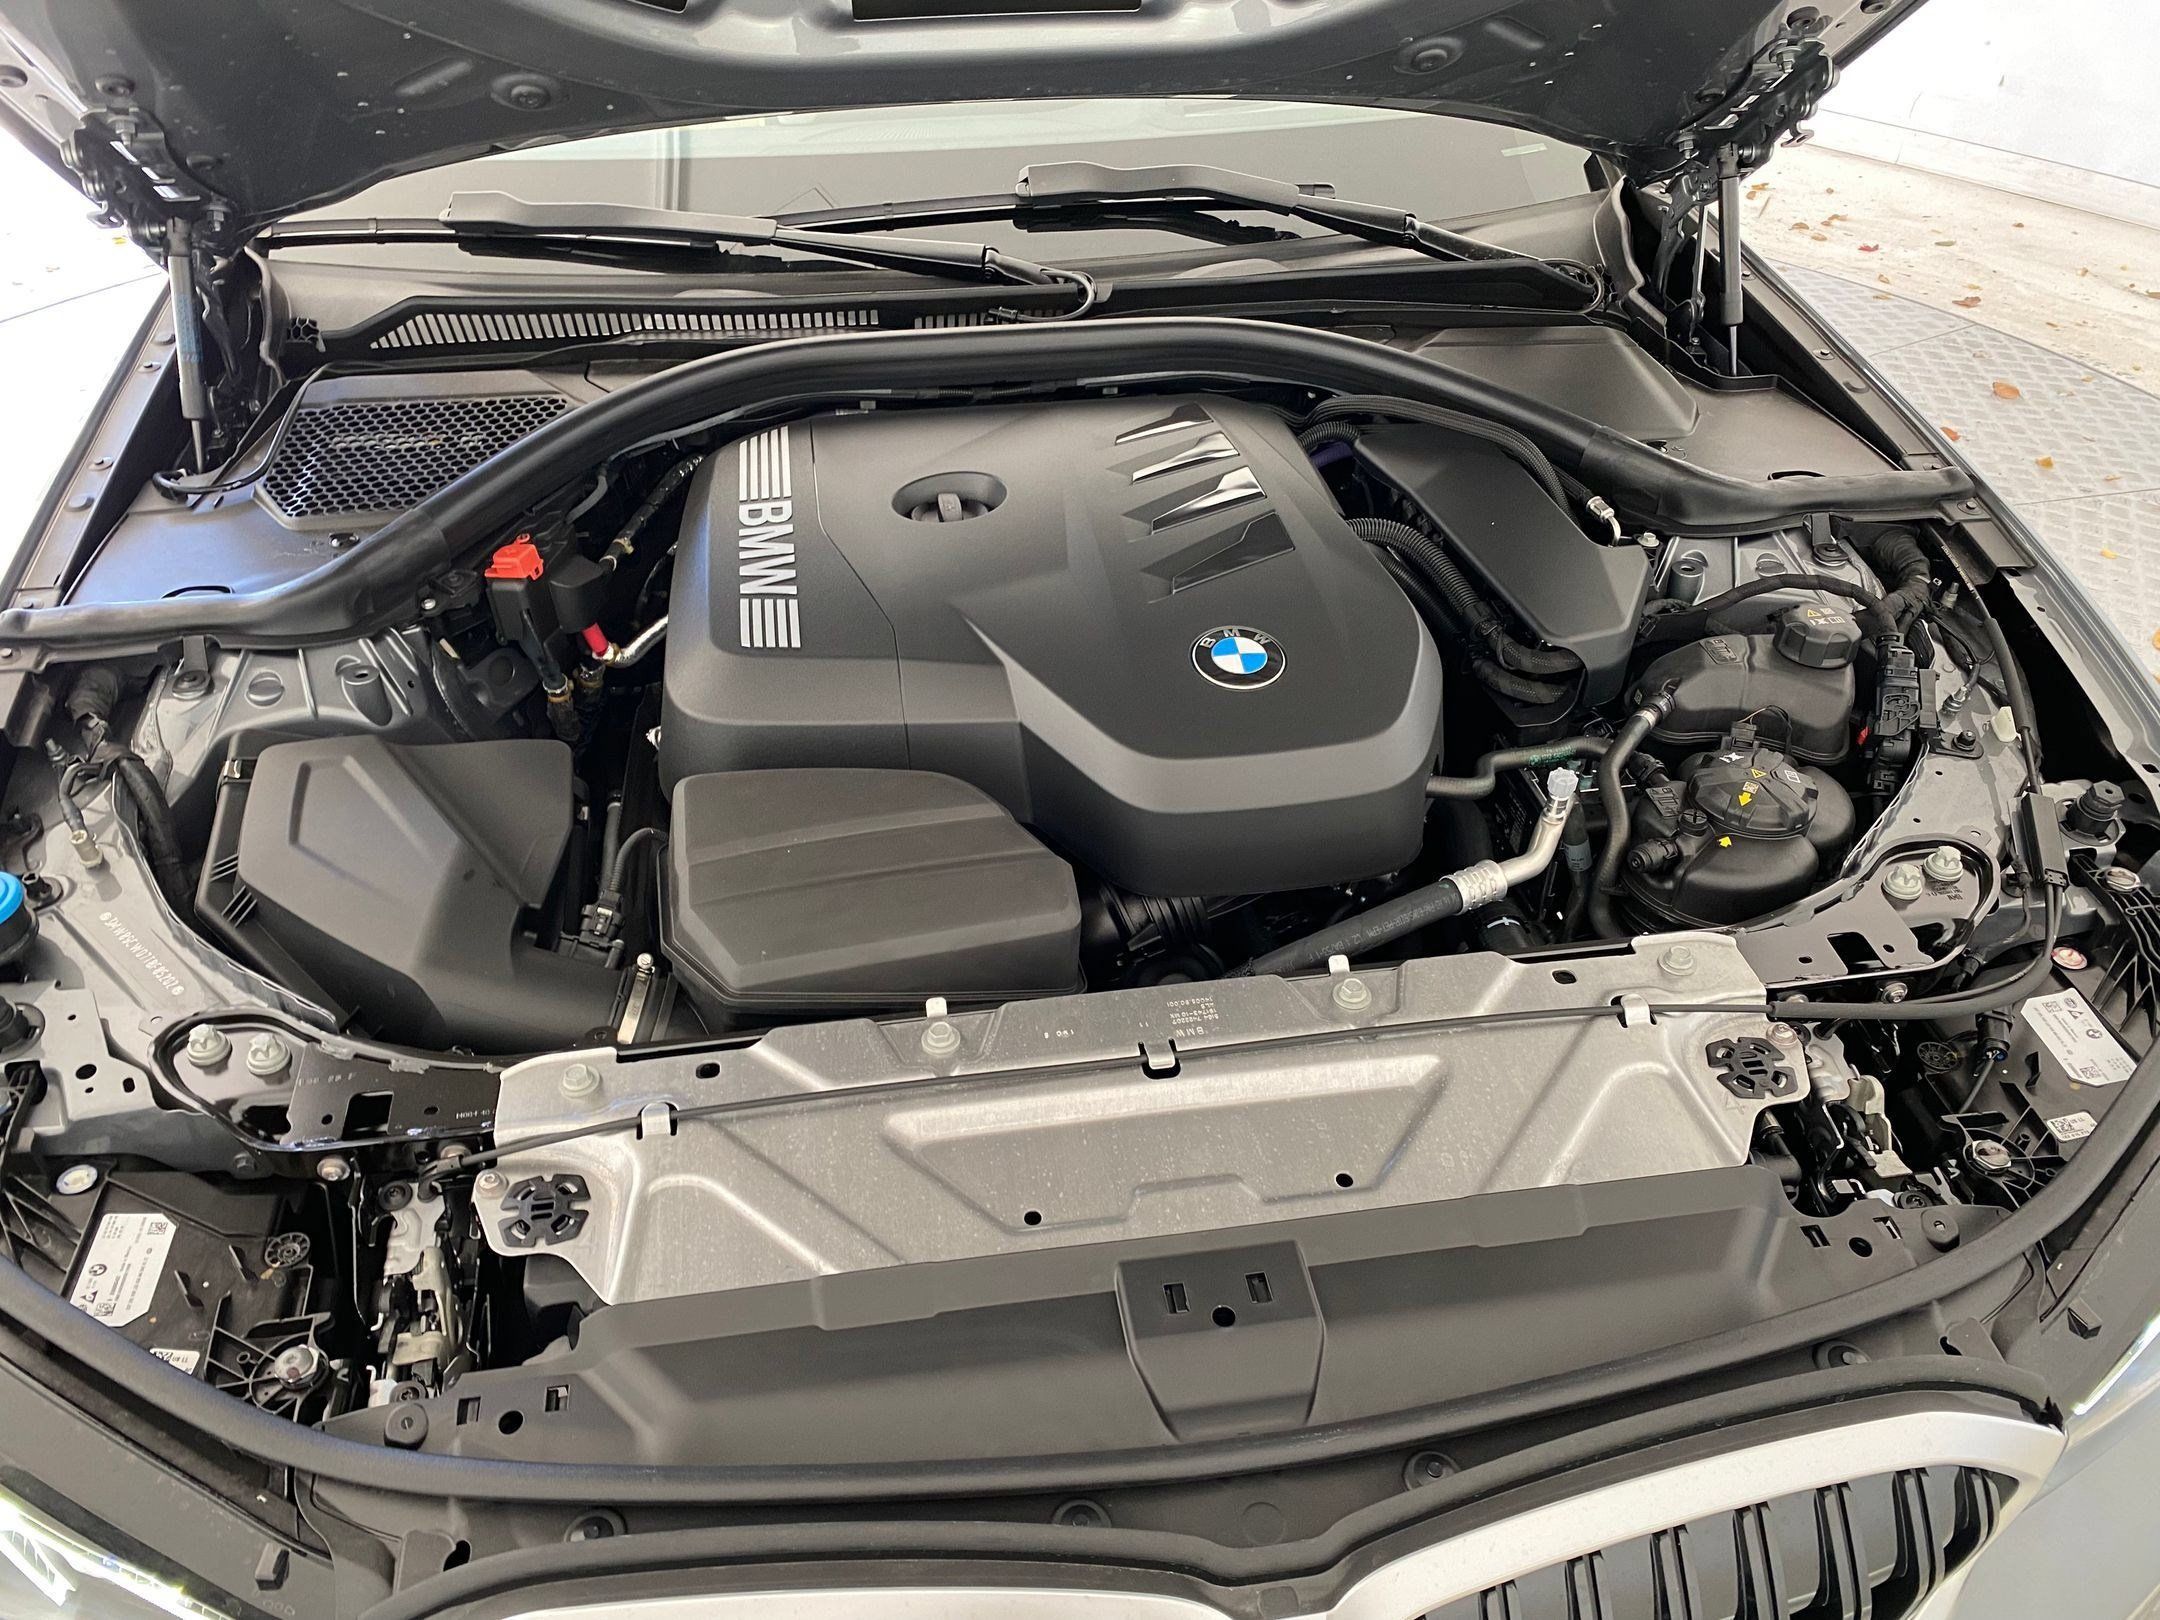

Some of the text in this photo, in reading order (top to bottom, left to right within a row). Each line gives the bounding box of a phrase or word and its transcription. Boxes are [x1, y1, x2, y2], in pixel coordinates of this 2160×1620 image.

[739, 500, 797, 595] BMW
[1200, 628, 1271, 649] BMW
[1175, 1026, 1204, 1038] BMW
